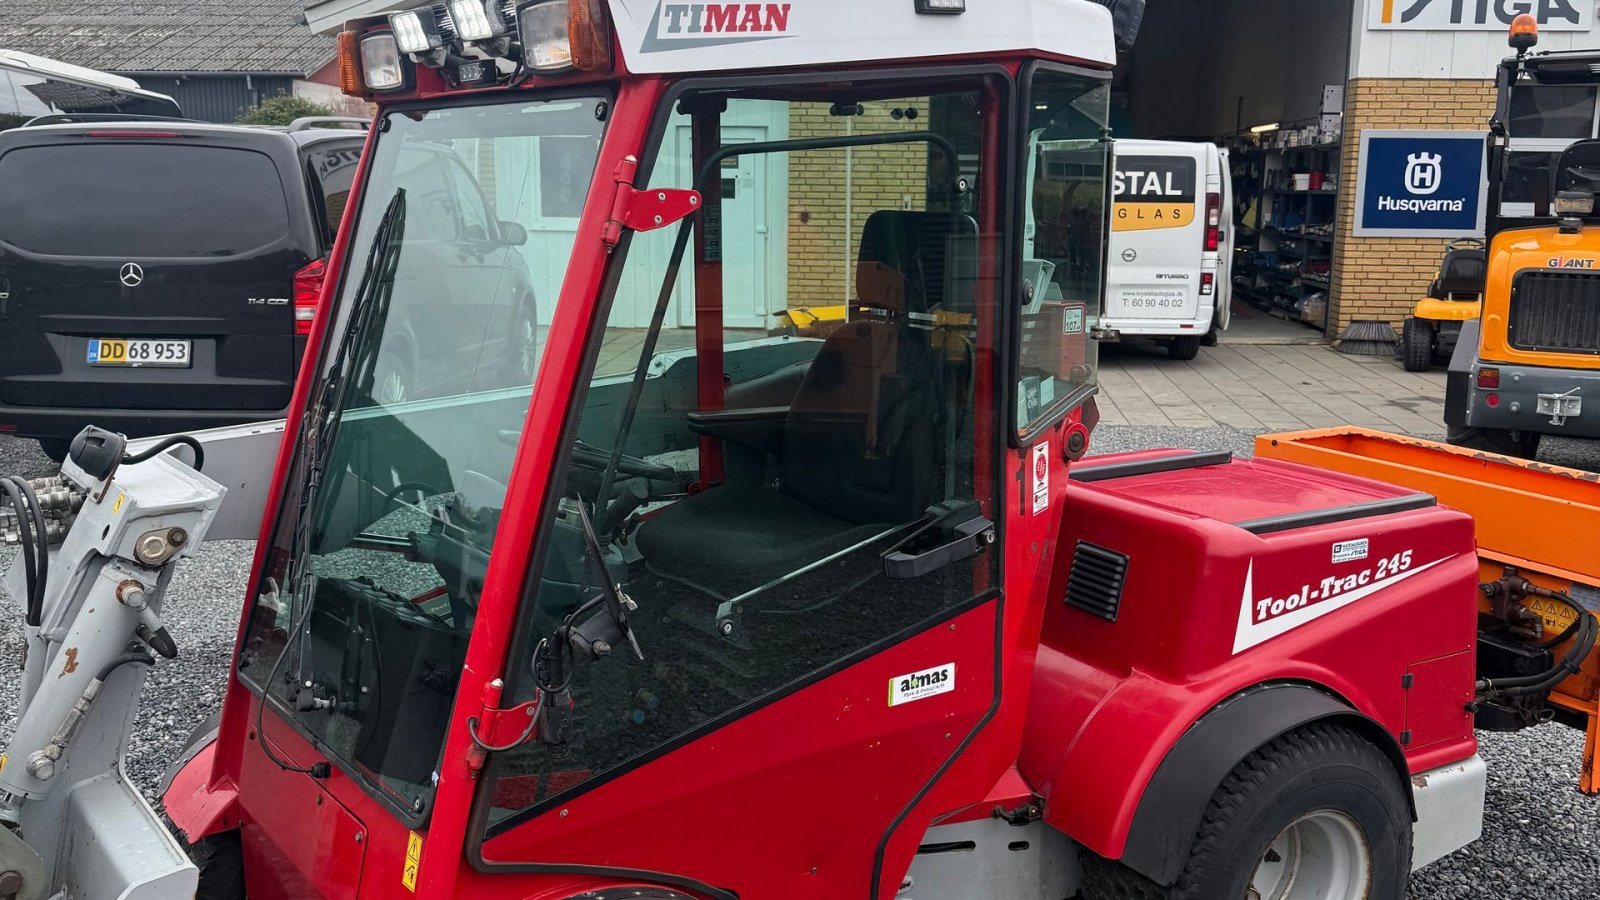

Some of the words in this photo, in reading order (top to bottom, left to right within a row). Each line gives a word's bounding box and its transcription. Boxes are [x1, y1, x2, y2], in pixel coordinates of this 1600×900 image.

[665, 3, 792, 34] TIMAN
[1378, 196, 1463, 213] Husqvarna
[1118, 208, 1181, 219] GLAS
[1131, 298, 1143, 307] 60
[1145, 298, 1156, 307] 90
[1158, 298, 1170, 307] 40
[1171, 298, 1183, 307] 02
[100, 342, 125, 359] DD
[128, 342, 150, 359] 68
[154, 343, 186, 360] 953
[1256, 569, 1371, 621] Tool-Trac
[1375, 549, 1413, 580] 245
